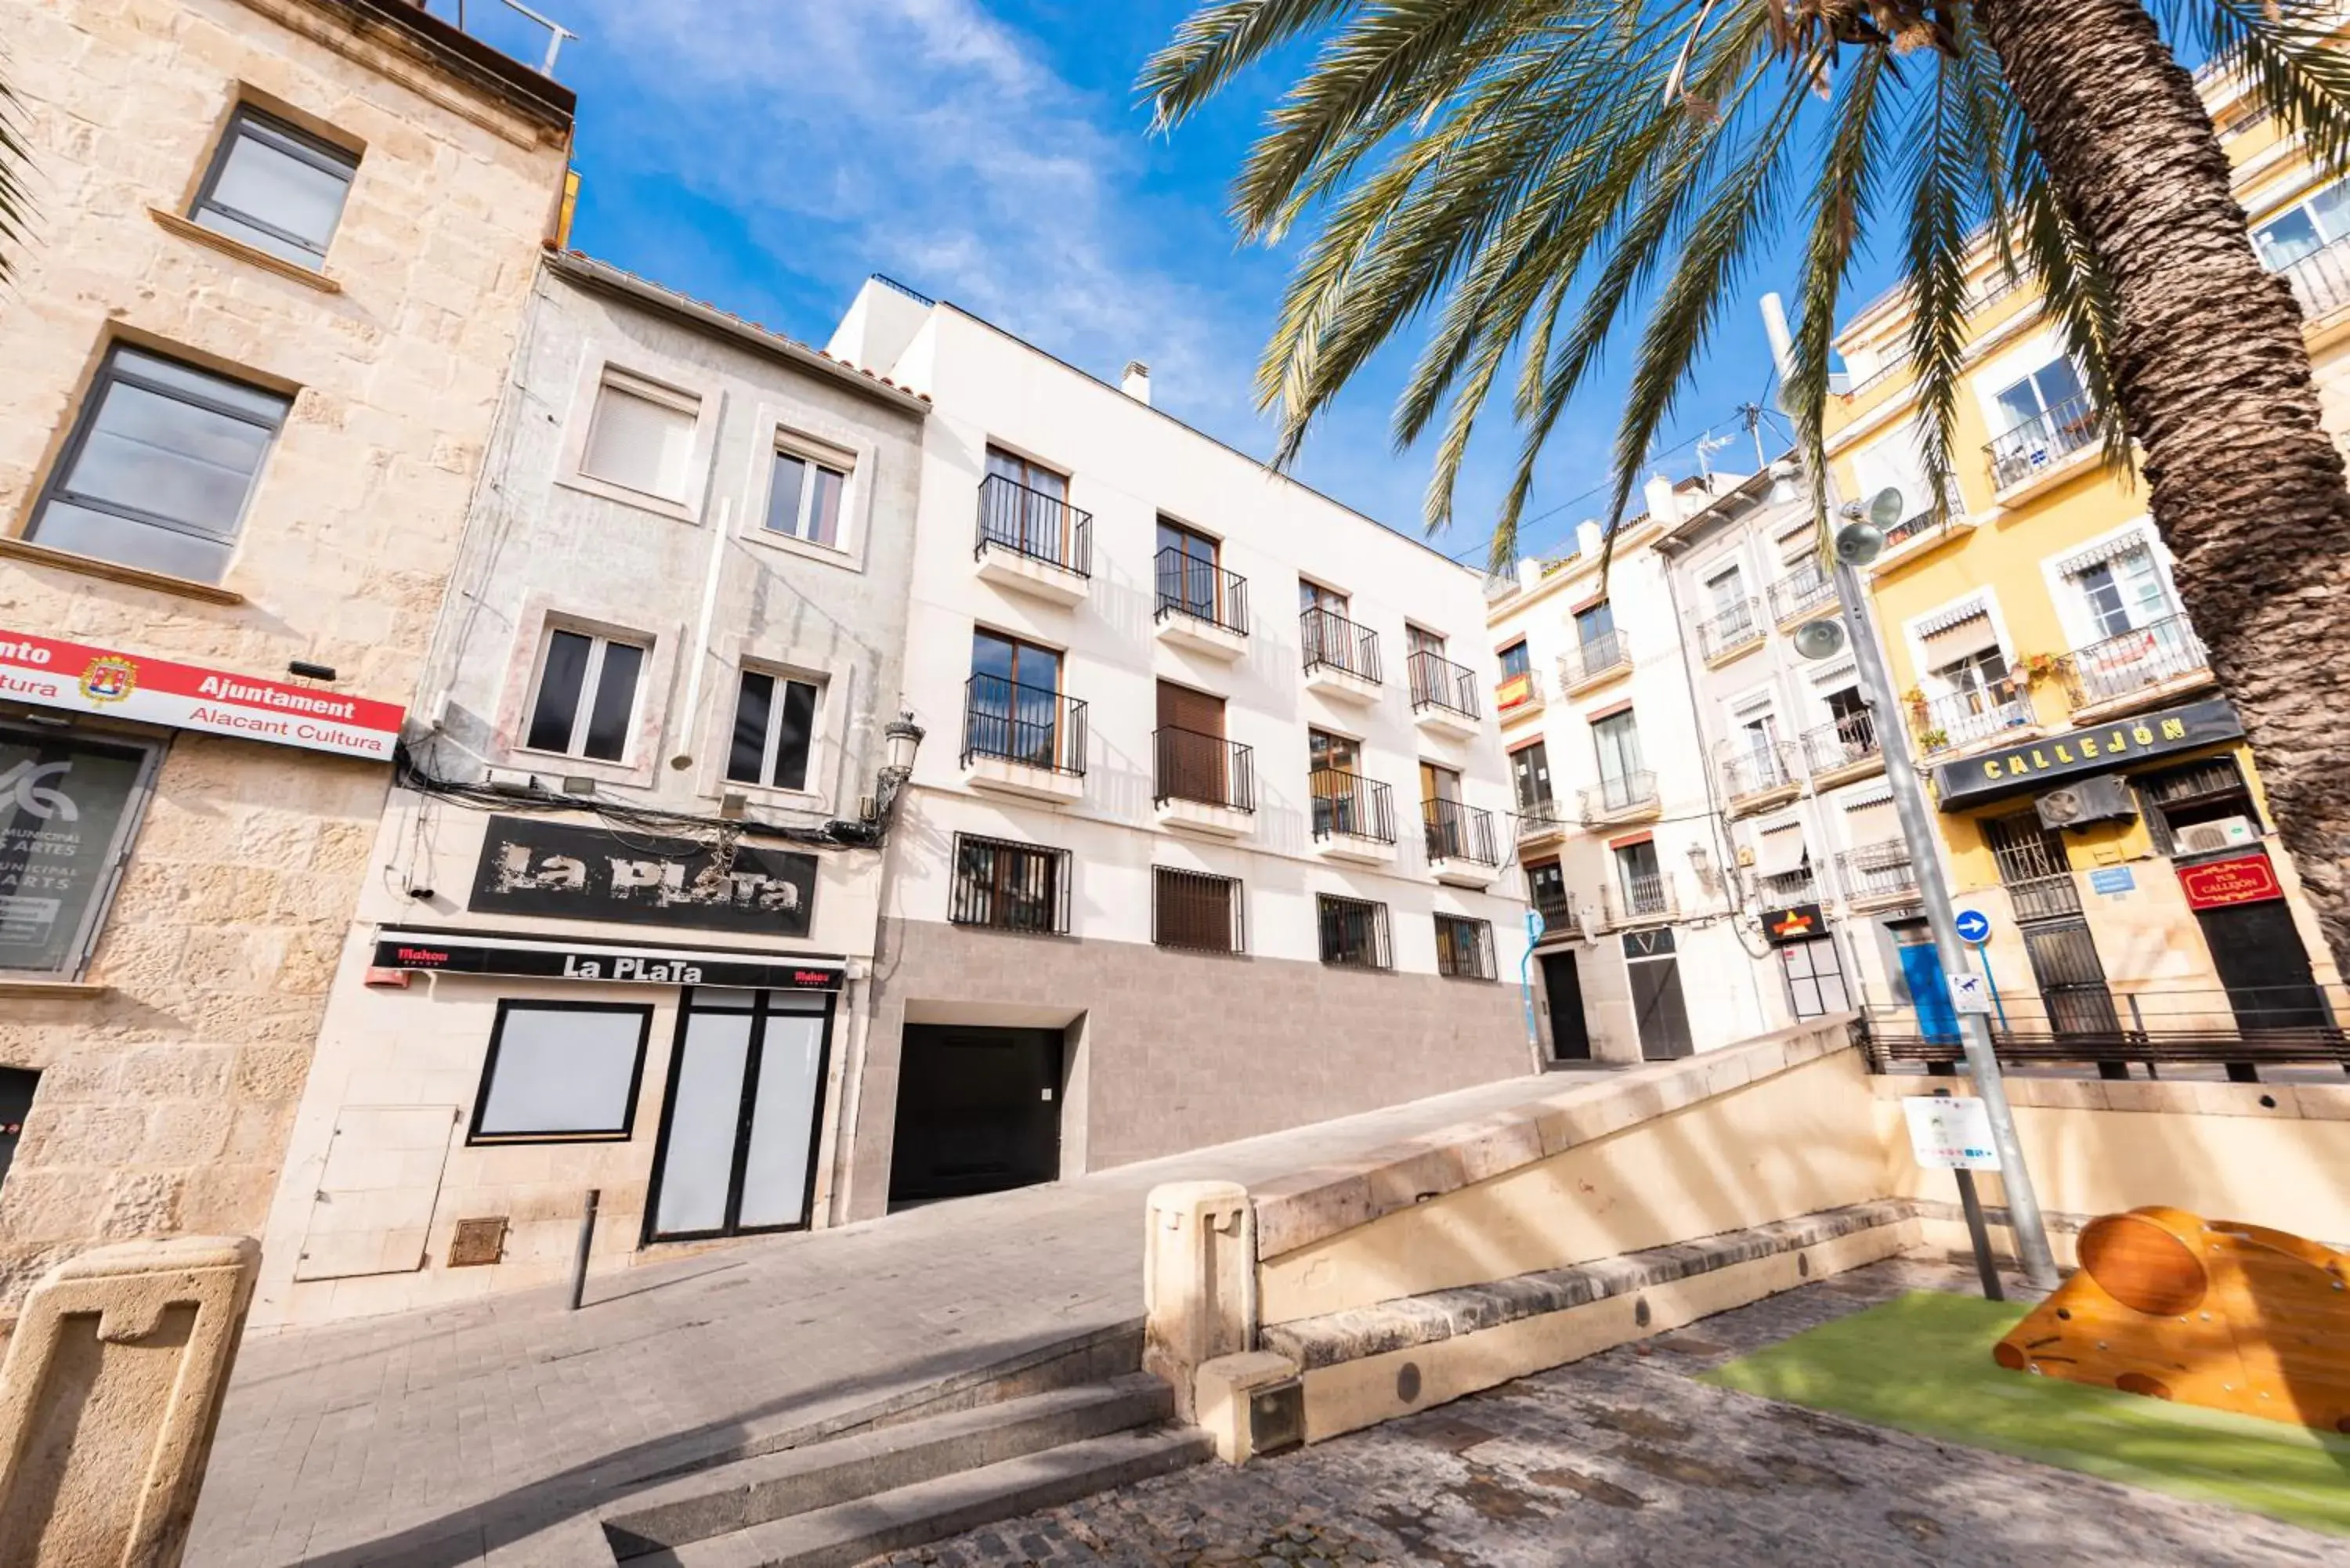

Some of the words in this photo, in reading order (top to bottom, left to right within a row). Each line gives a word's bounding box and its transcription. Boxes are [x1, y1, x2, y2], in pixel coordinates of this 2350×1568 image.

[198, 676, 356, 719] Ajuntament
[189, 706, 289, 736] Alacant
[297, 724, 383, 752] Cultura
[2, 828, 81, 844] MUNICIPAL
[13, 840, 77, 856] ARTES
[2, 874, 70, 890] ARTS
[563, 955, 601, 978] La
